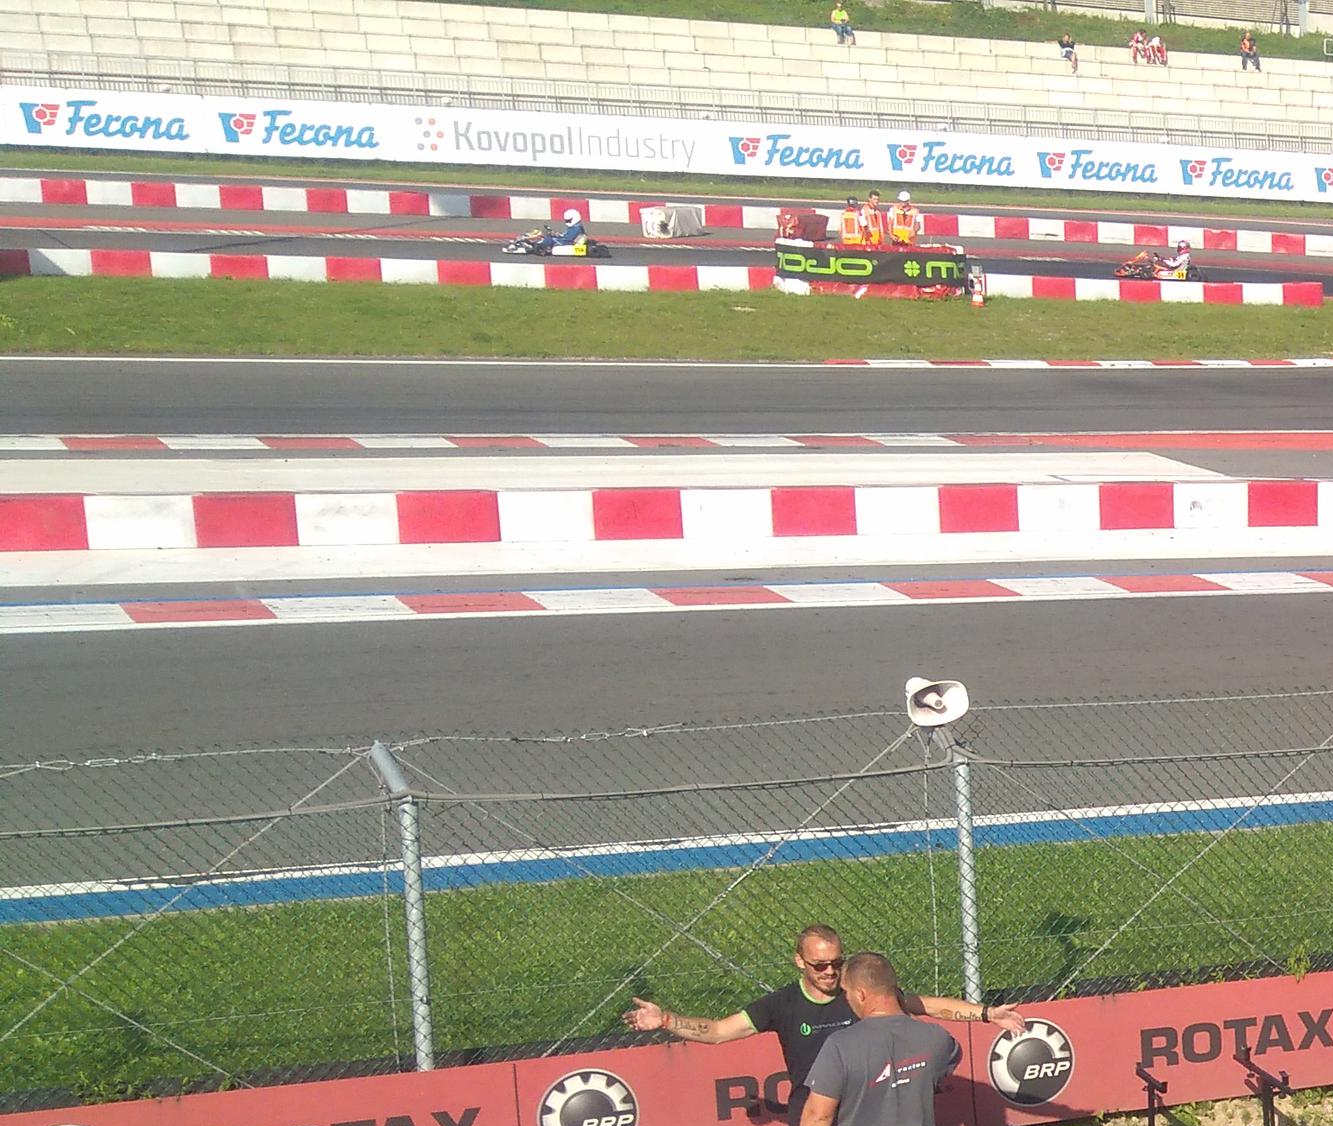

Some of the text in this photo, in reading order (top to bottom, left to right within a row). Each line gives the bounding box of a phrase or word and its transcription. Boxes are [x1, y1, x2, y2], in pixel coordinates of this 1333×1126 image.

[66, 100, 190, 140] Ferona
[262, 110, 379, 149] Ferona
[764, 133, 864, 169] Ferona
[921, 141, 1015, 177] Ferona
[1068, 149, 1158, 183] Ferona
[1209, 157, 1294, 191] Ferona
[1023, 1060, 1072, 1081] BRP
